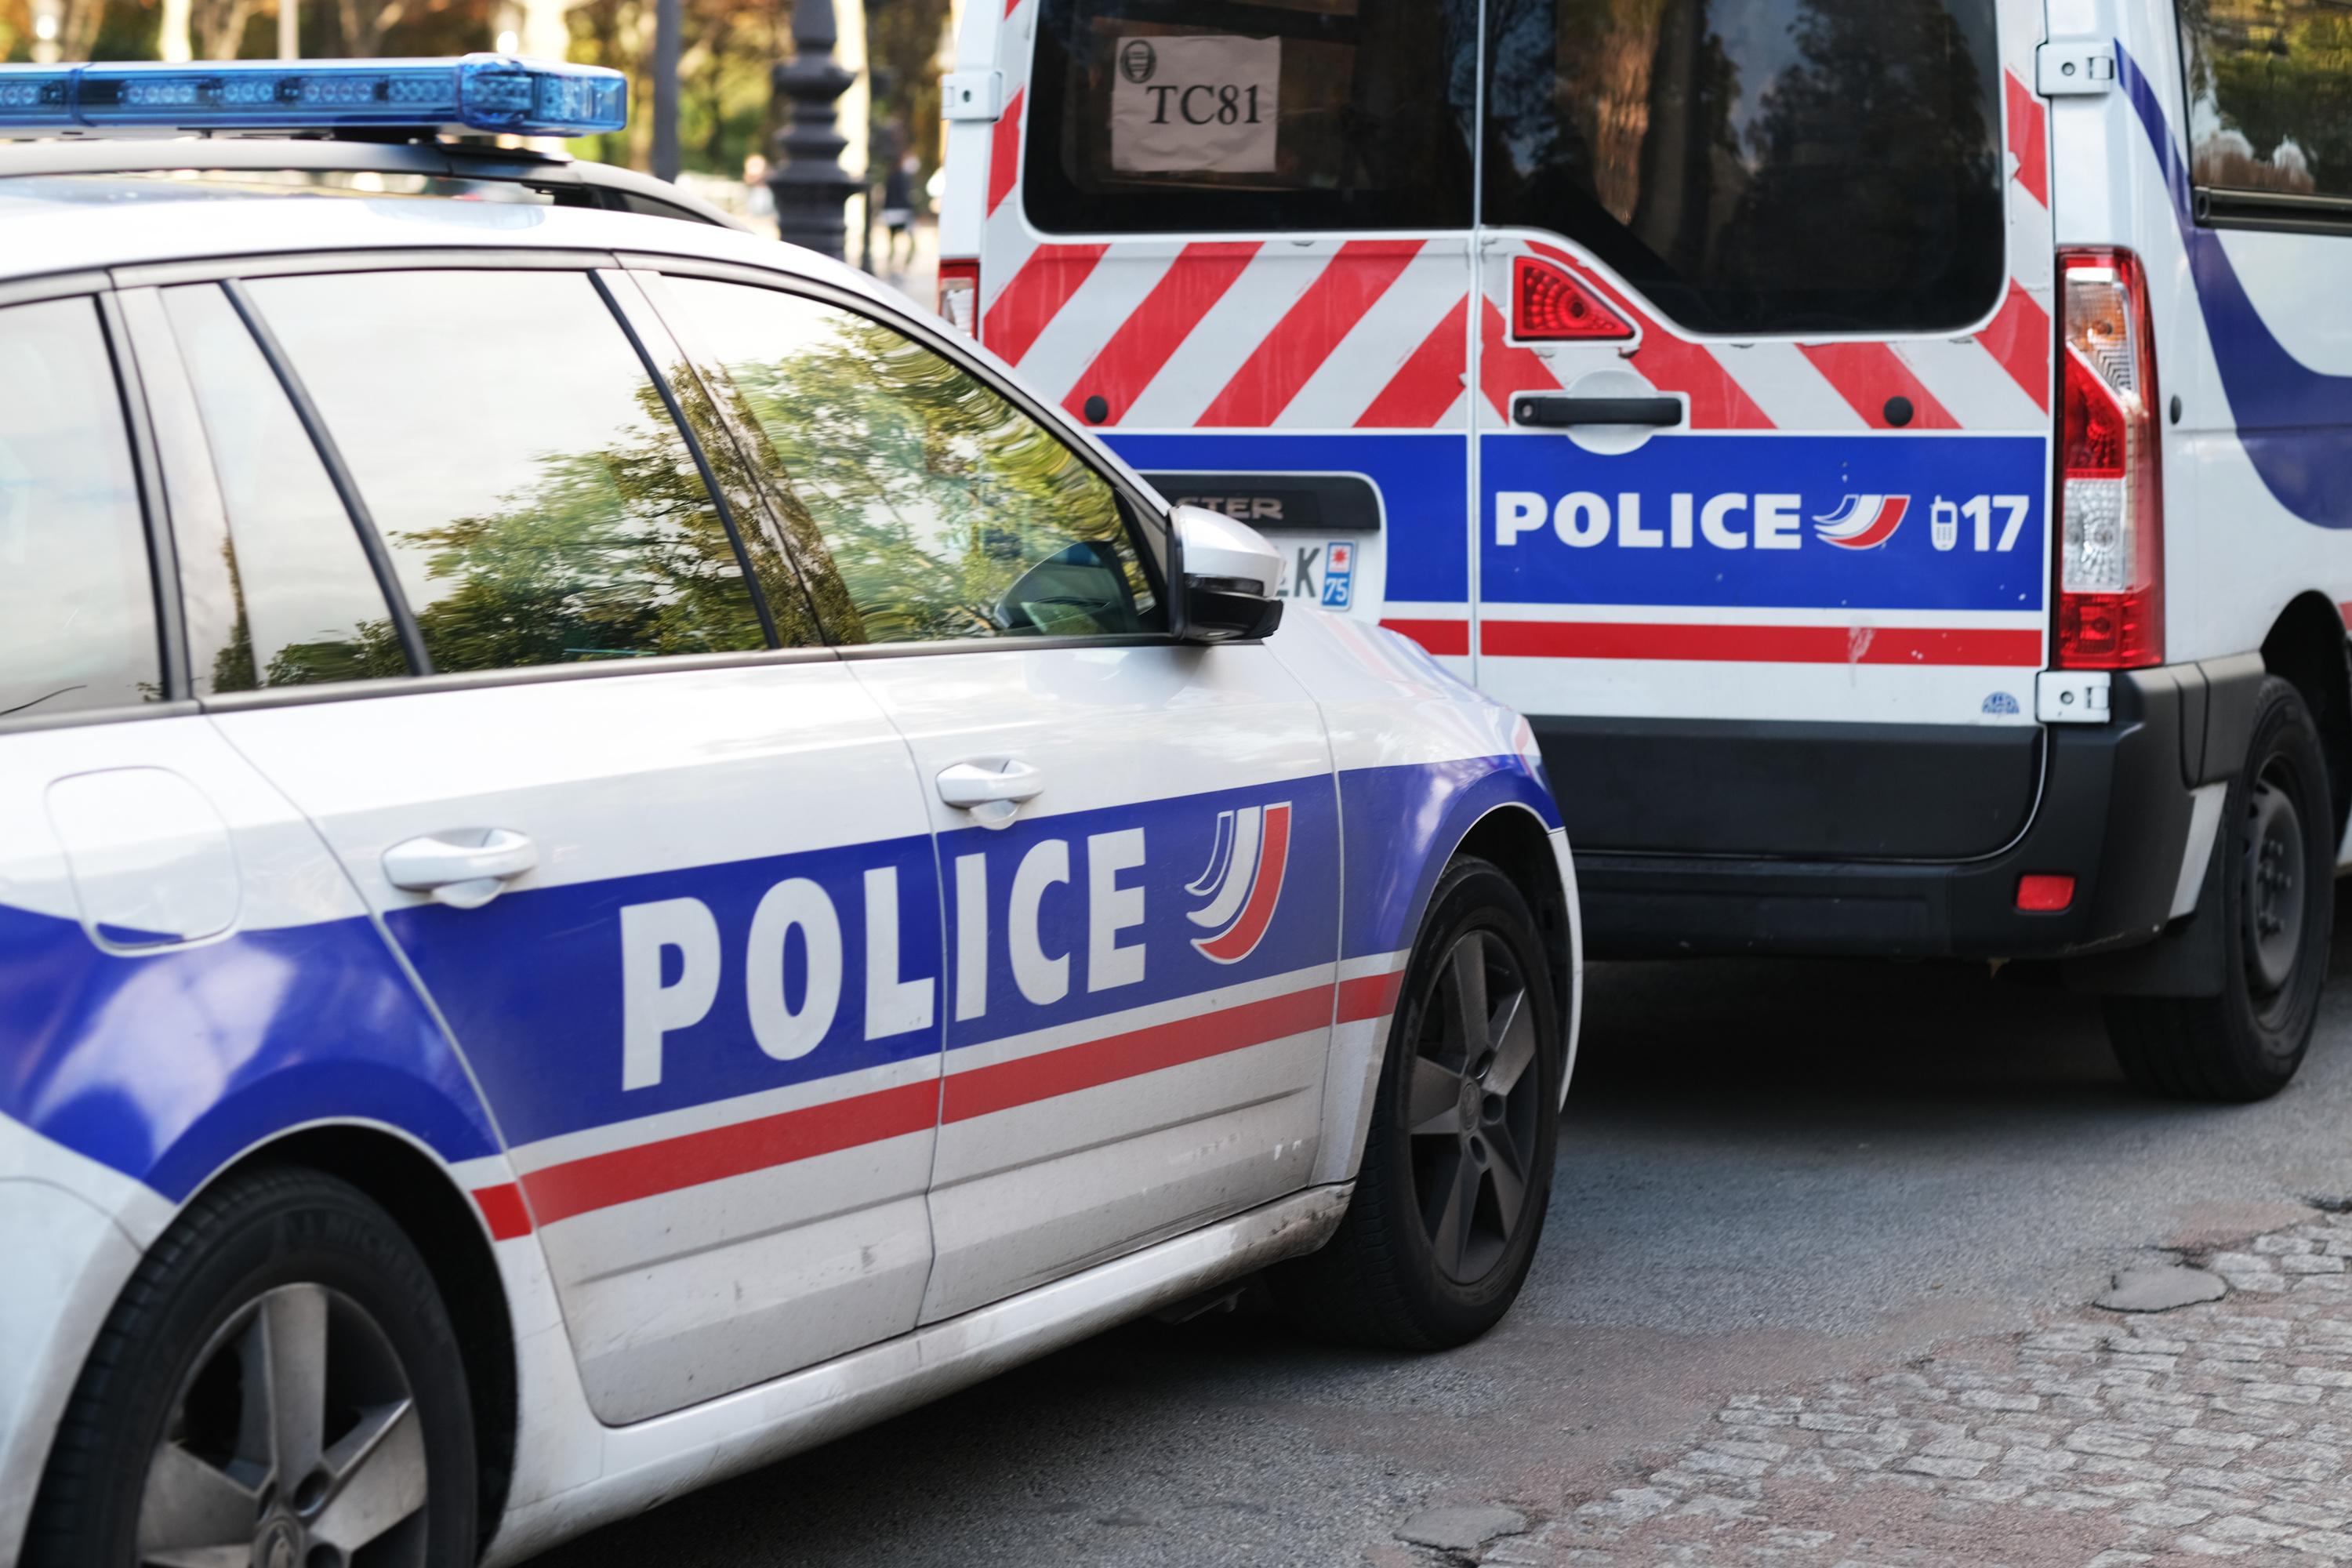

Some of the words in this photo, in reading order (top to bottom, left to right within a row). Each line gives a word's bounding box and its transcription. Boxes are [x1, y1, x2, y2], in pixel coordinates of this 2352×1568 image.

[1145, 84, 1262, 125] TC81
[1495, 491, 1802, 549] POLICE
[1961, 495, 2030, 552] 17
[1276, 547, 1320, 597] K
[1324, 577, 1349, 602] 75
[620, 826, 1146, 1092] POLICE
